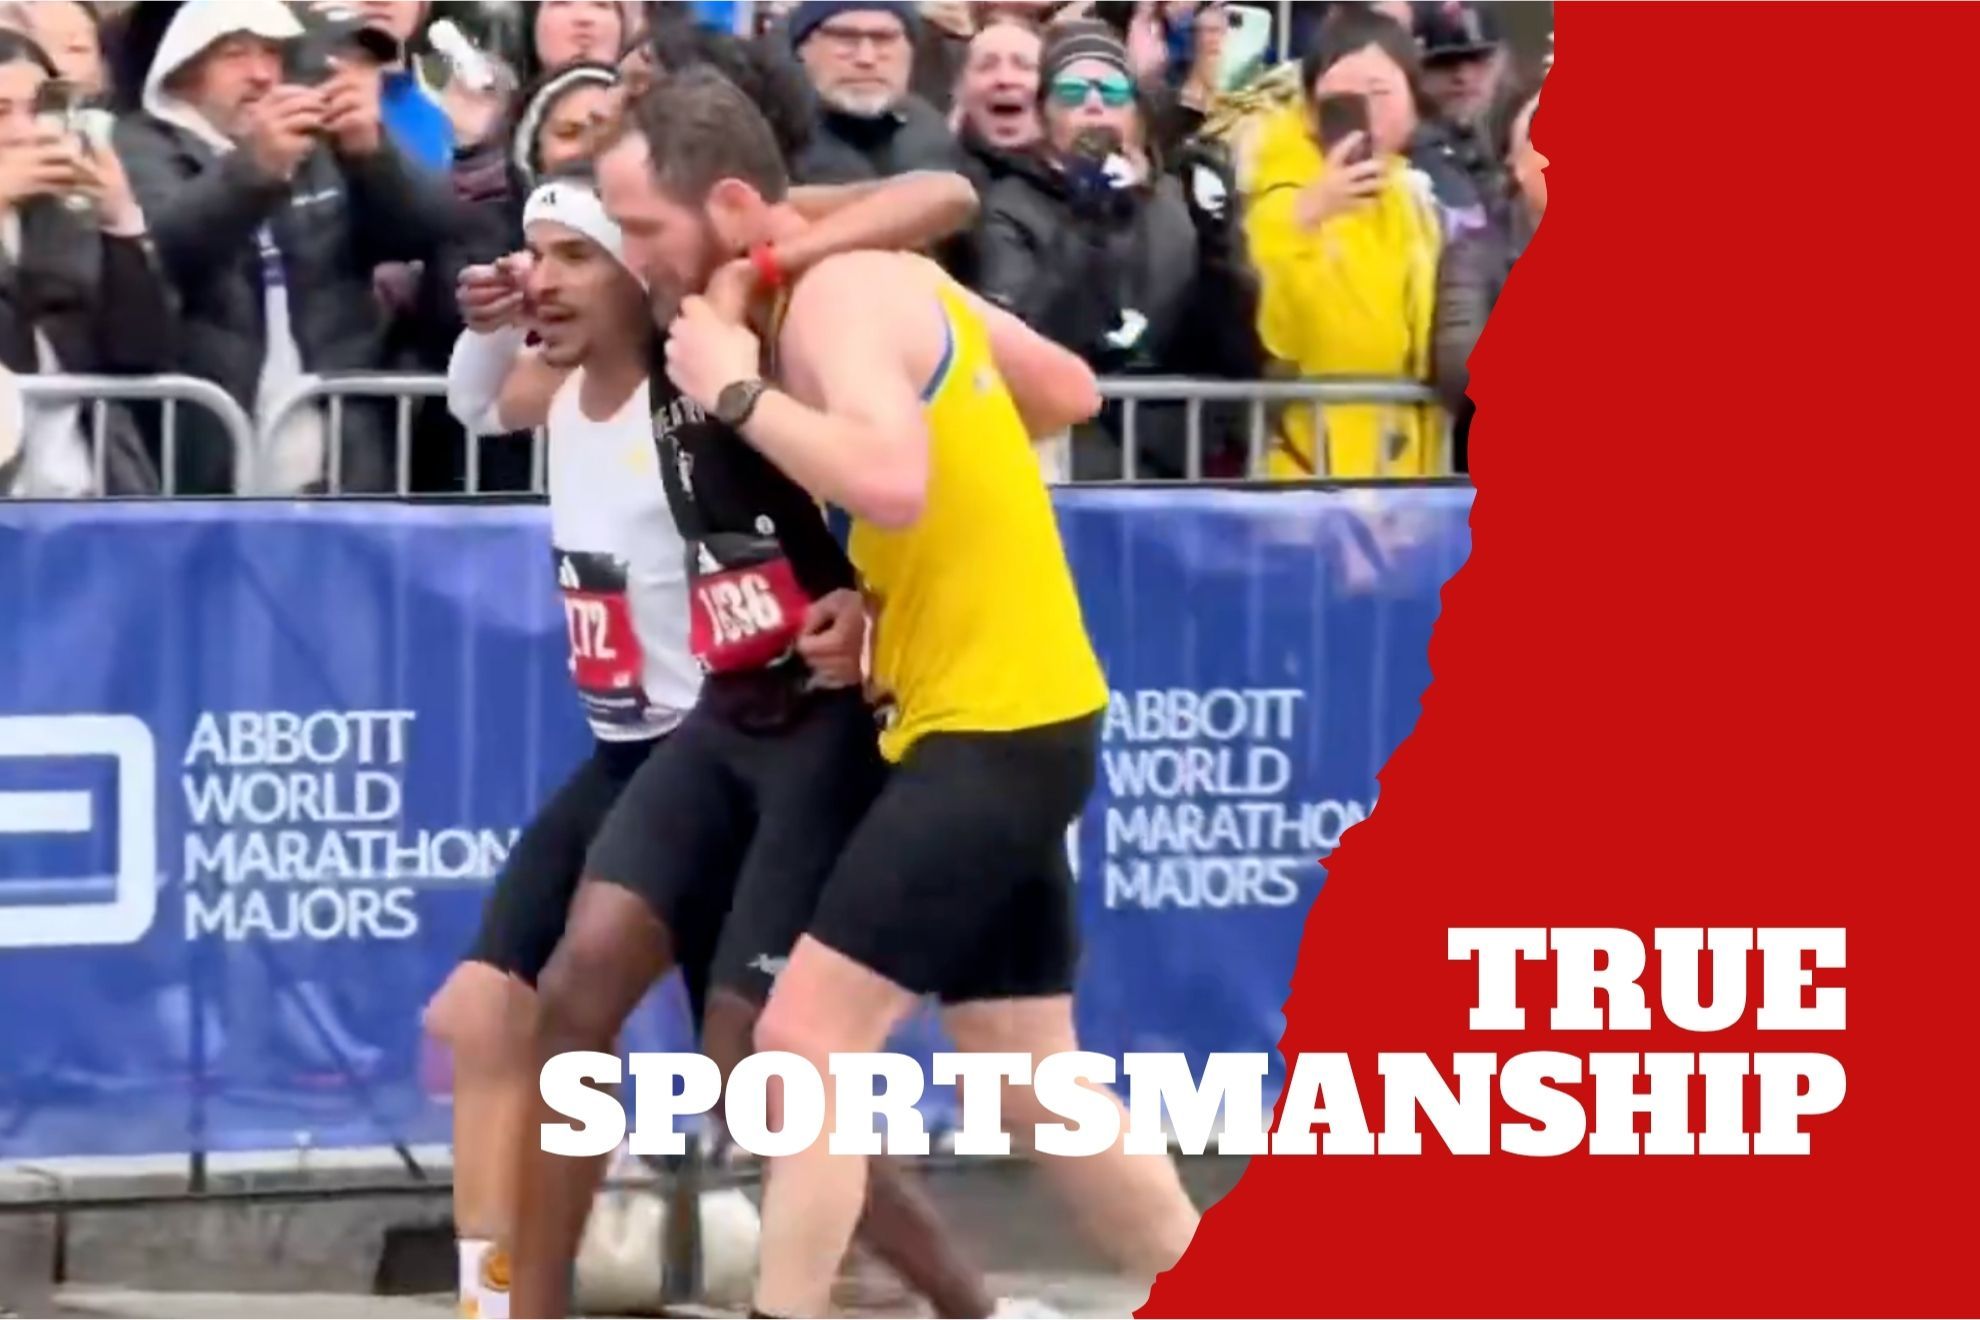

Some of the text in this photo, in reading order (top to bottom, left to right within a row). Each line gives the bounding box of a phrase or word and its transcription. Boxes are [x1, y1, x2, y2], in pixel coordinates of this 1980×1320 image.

[183, 709, 417, 766] ABBOTT
[1102, 687, 1306, 742] ABBOTT
[181, 771, 401, 824] WORLD
[1102, 746, 1292, 798] WORLD
[183, 827, 521, 884] MARATHON
[1105, 857, 1299, 911] MAJORS
[184, 887, 419, 942] MAJORS
